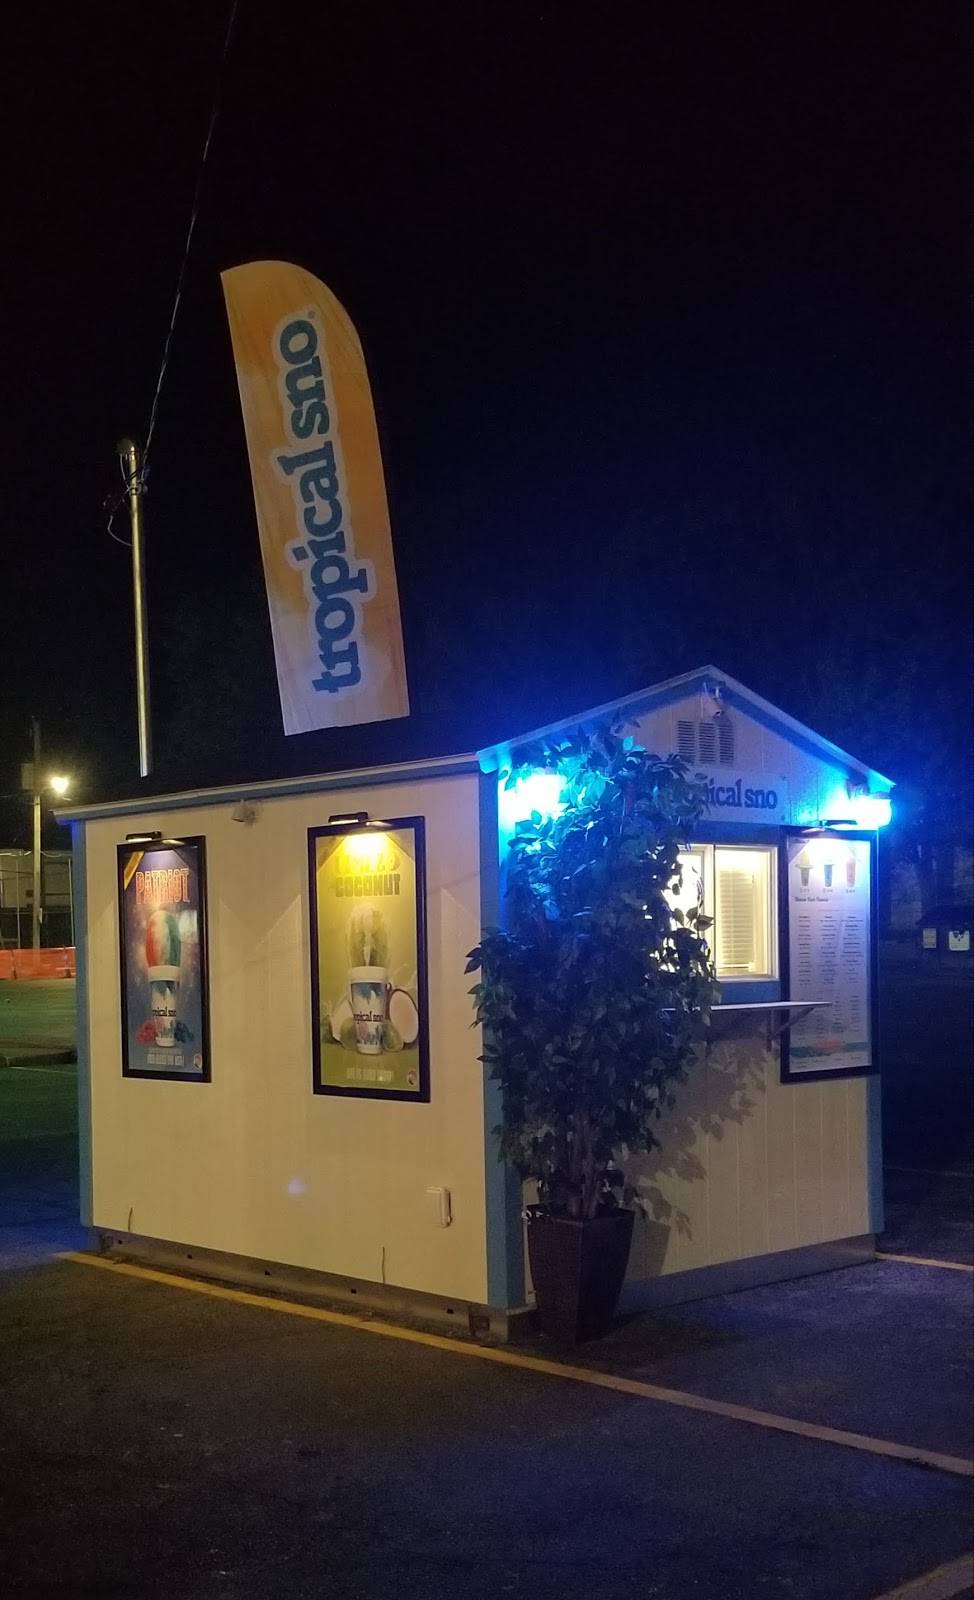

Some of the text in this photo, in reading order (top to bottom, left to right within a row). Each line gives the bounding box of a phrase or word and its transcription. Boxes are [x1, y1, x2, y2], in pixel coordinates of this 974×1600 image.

[278, 319, 369, 694] tropical sno
[707, 778, 778, 809] ical sno
[136, 868, 190, 904] PATRIOT
[335, 874, 401, 897] COCONUT
